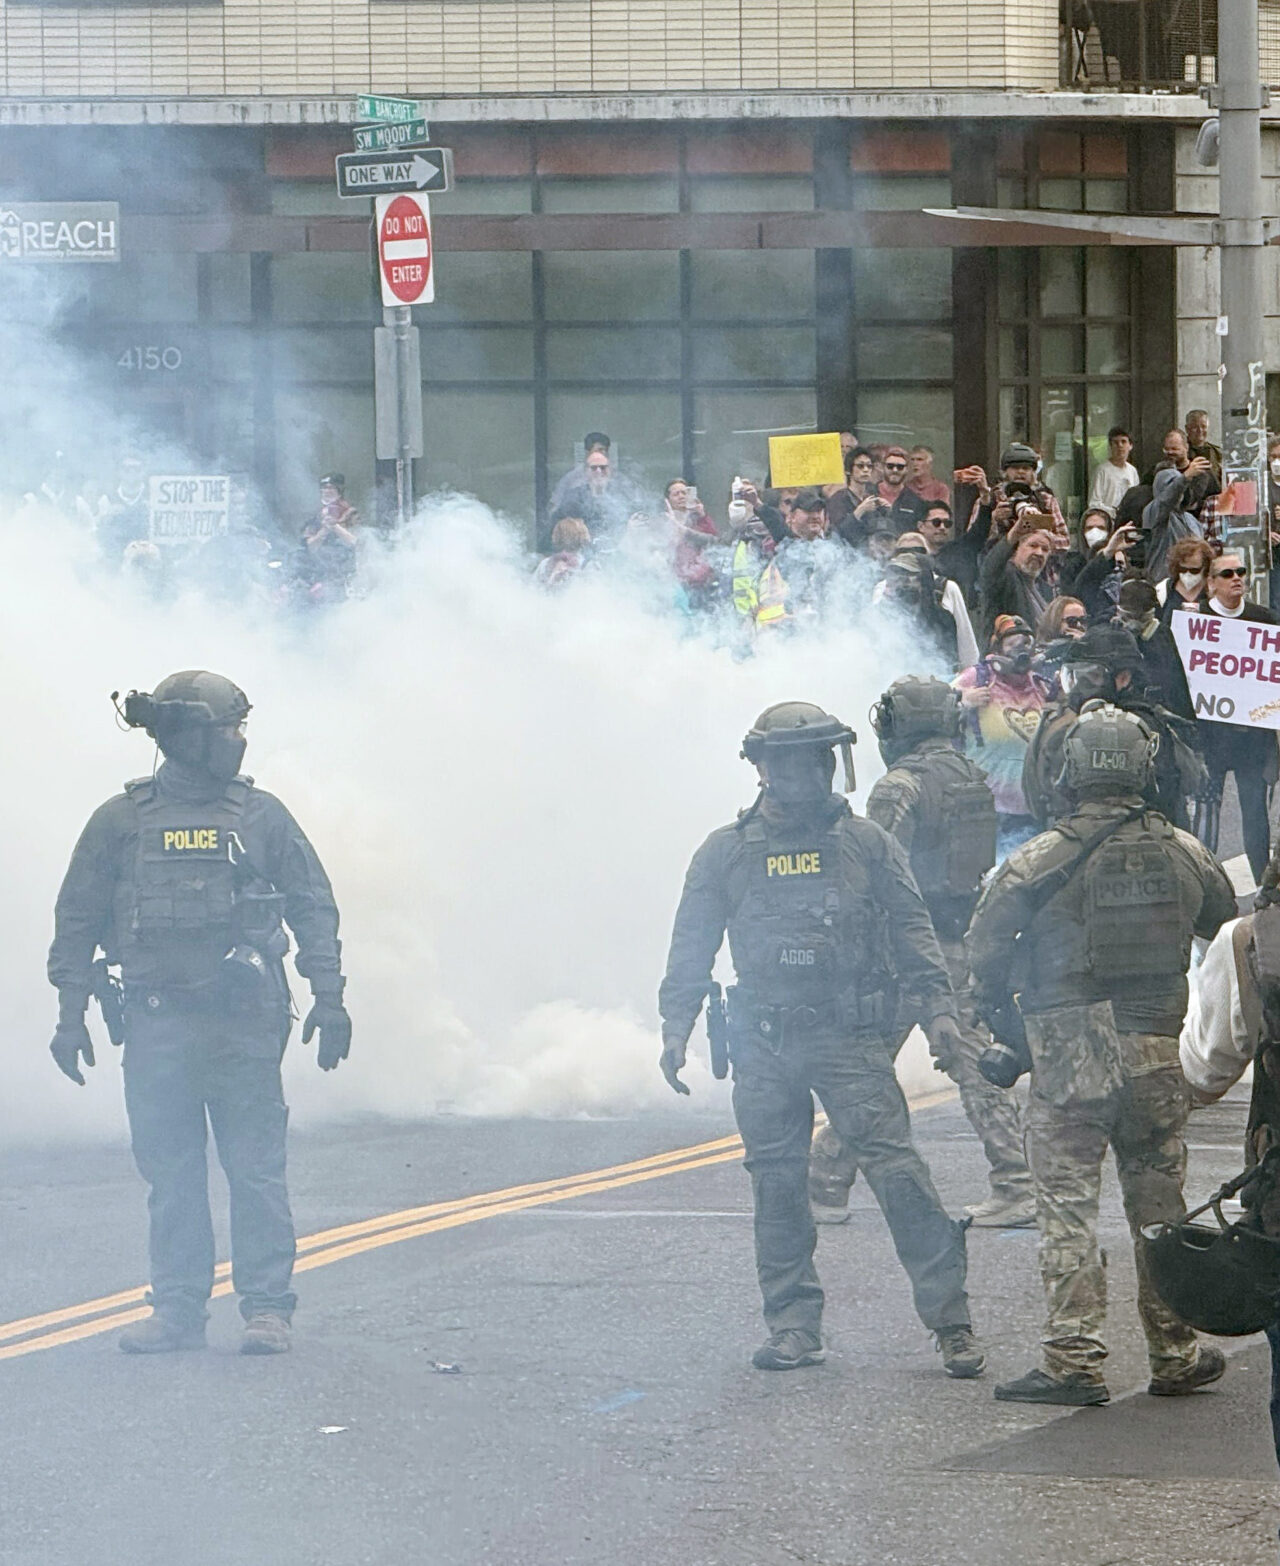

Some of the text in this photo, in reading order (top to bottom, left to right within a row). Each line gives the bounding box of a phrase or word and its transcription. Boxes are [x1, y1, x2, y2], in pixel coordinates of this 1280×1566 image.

[375, 100, 412, 119] BANCROFT
[356, 132, 372, 149] SW
[376, 124, 412, 147] MOODY
[349, 164, 412, 184] ONE WAY
[22, 221, 115, 249] REACH
[386, 215, 423, 235] DO NOT
[392, 265, 423, 283] ENTER
[117, 346, 182, 370] 4150
[157, 480, 226, 504] STOP THE
[1188, 618, 1222, 643] WE
[1195, 692, 1235, 719] NO
[164, 829, 218, 851] POLICE
[767, 852, 821, 877] POLICE
